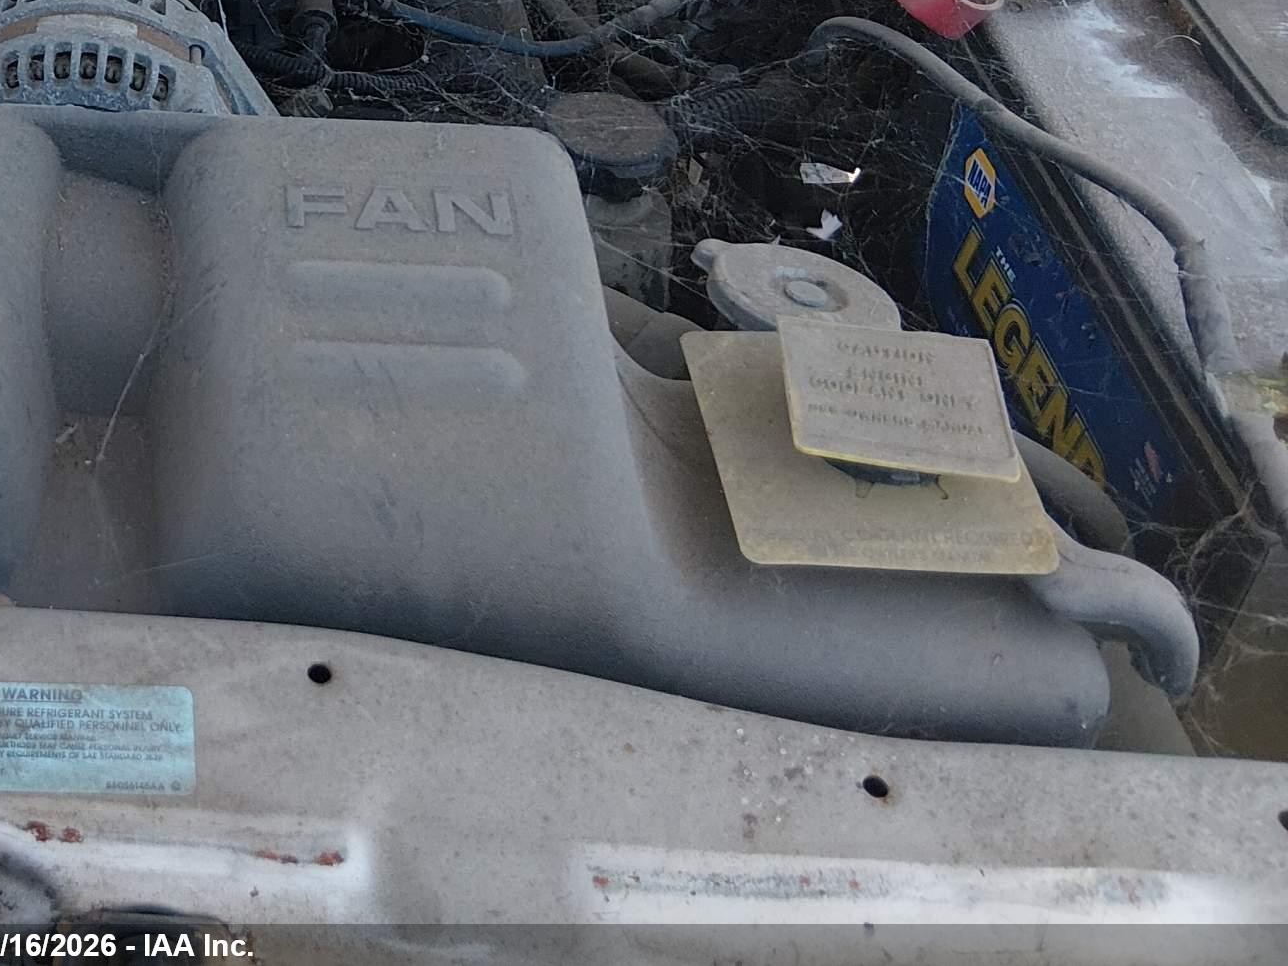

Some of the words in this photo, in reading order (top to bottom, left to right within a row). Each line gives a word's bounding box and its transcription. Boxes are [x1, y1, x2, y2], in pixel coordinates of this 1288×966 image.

[967, 159, 992, 208] NAPA
[286, 185, 514, 235] FAN
[2, 687, 83, 701] WARNING
[27, 707, 106, 720] REFRIGERANT
[108, 709, 153, 721] SYSTEM
[15, 719, 75, 731] QUALIFIED
[79, 720, 146, 731] PERSONNEL
